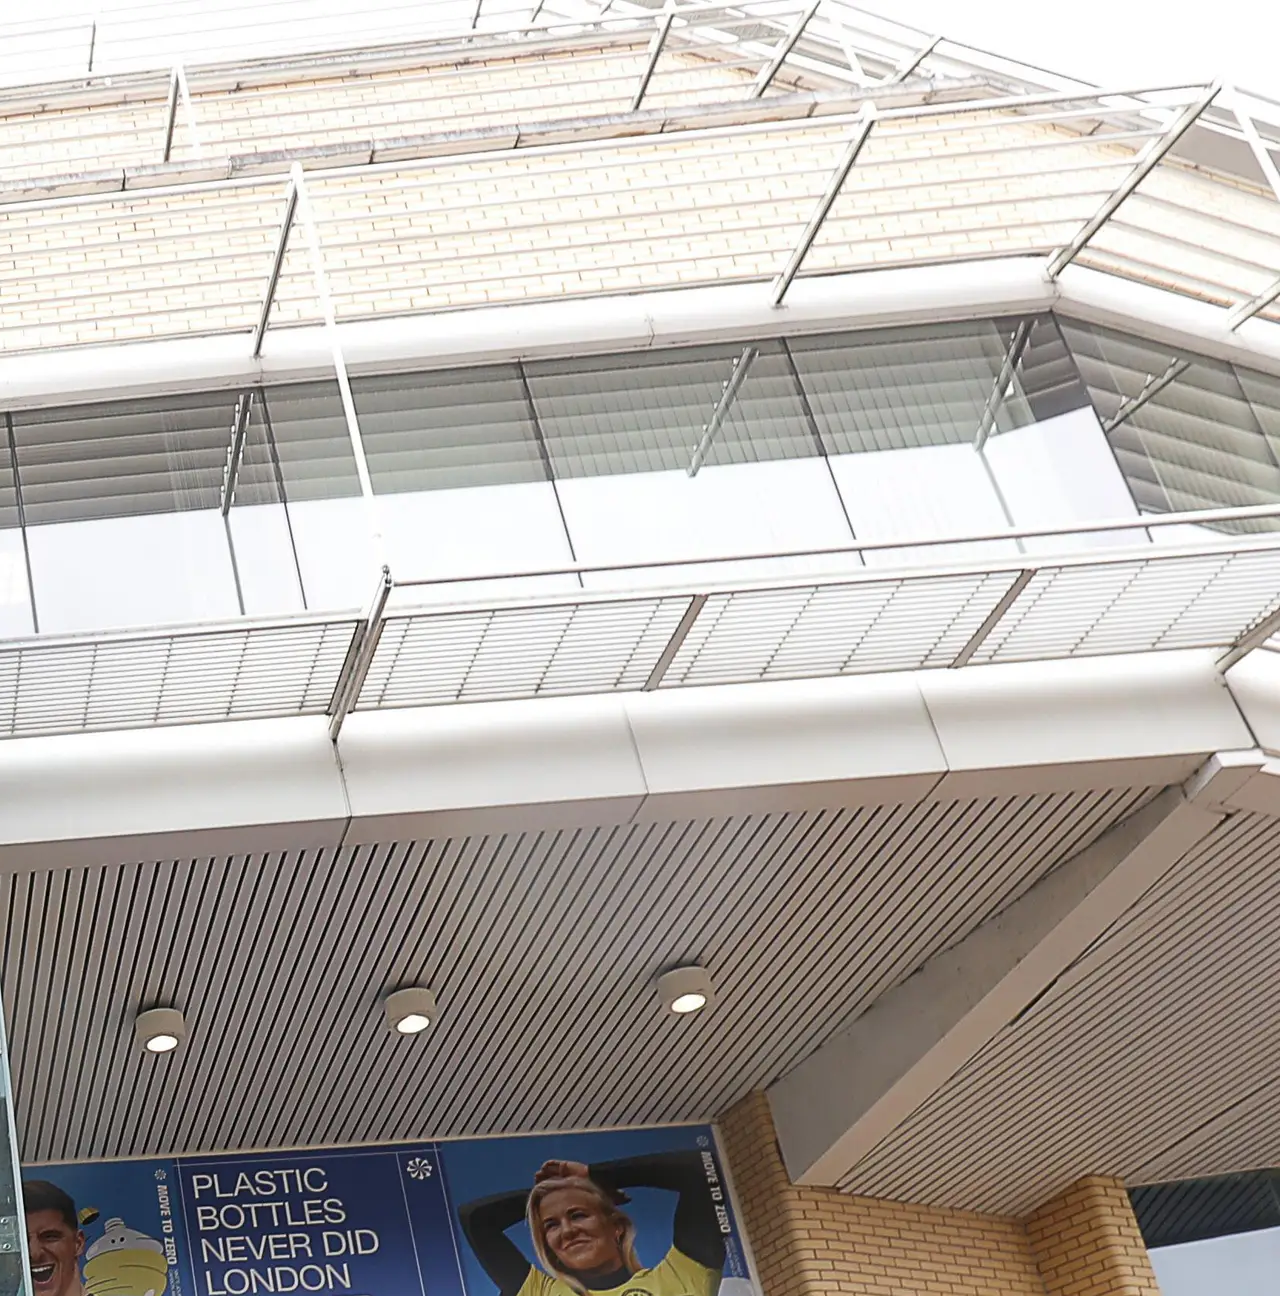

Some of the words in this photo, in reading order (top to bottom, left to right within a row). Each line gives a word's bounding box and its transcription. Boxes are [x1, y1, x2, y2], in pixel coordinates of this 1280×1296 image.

[192, 1168, 328, 1199] PLASTIC
[701, 1151, 719, 1184] MOVE
[157, 1184, 171, 1217] MOVE
[710, 1186, 723, 1201] TO
[161, 1219, 174, 1234] TO
[196, 1198, 346, 1231] BOTTLES
[714, 1204, 732, 1234] ZERO
[163, 1236, 178, 1265] ZERO
[201, 1233, 313, 1263] NEVER
[322, 1229, 380, 1257] DID
[205, 1263, 352, 1296] LONDON
